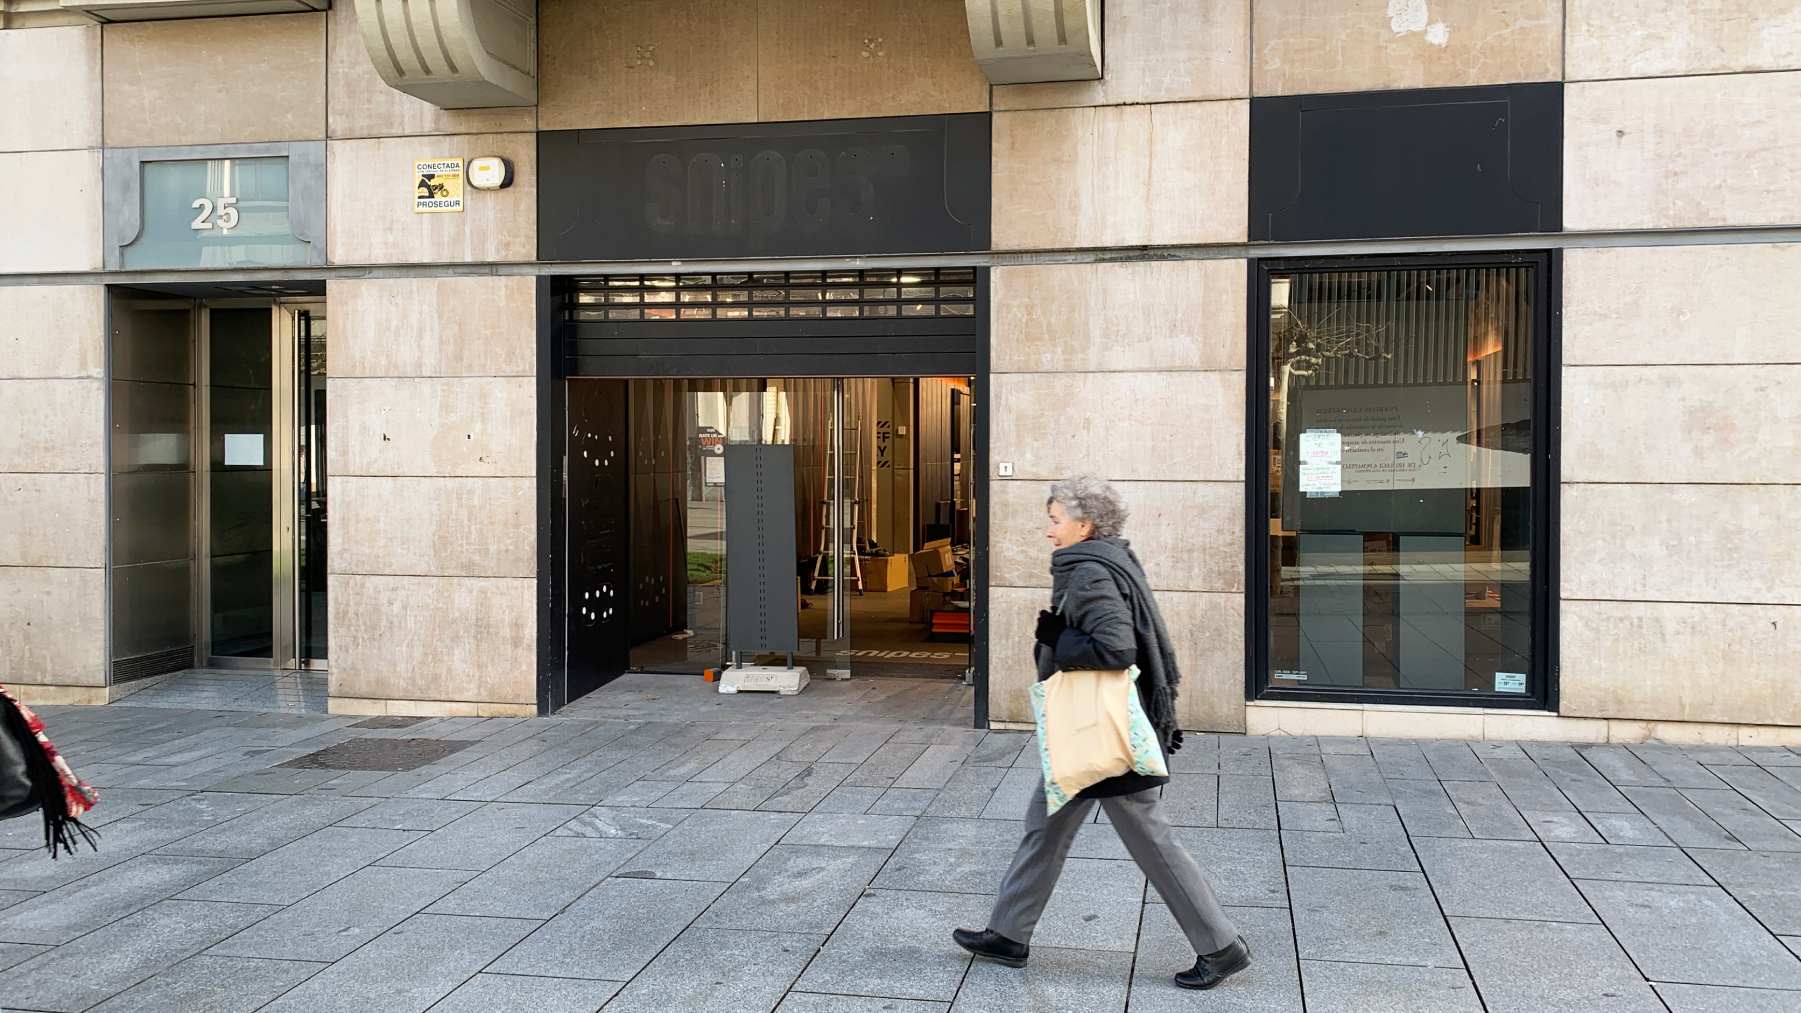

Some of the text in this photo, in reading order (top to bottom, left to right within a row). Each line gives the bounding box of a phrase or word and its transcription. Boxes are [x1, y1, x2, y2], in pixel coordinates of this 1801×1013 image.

[417, 162, 460, 170] CONECTADA
[416, 200, 461, 208] PROSEGUR
[191, 197, 239, 230] 25
